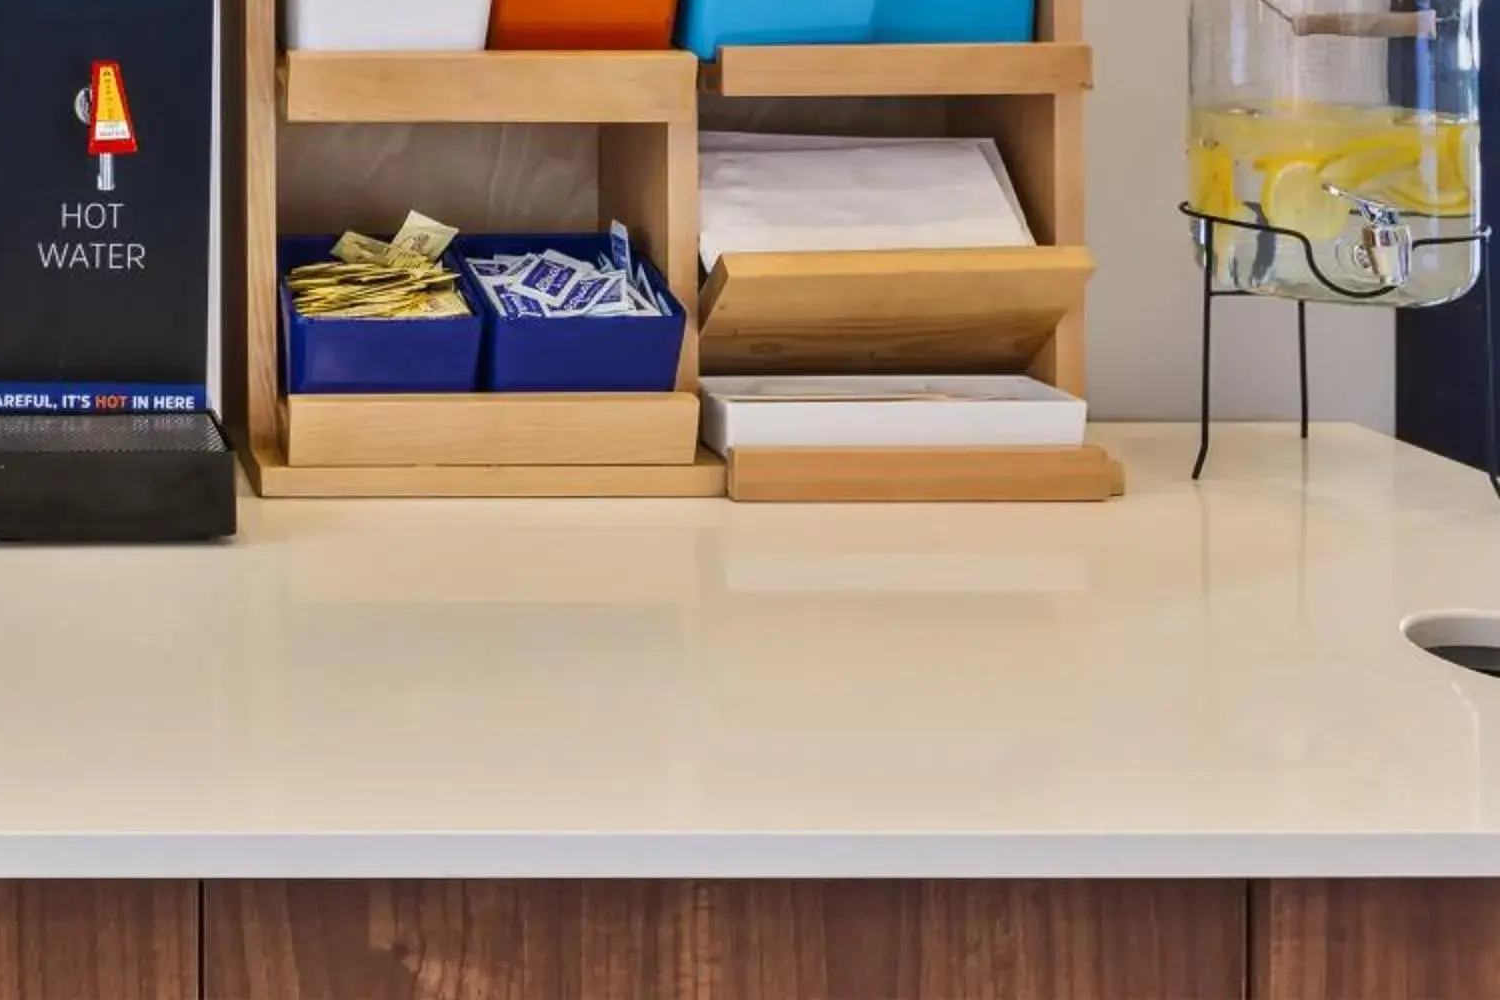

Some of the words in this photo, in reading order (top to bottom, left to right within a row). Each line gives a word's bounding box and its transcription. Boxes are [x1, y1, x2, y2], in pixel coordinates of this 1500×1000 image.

[61, 202, 125, 229] HOT
[37, 242, 146, 270] WATER
[62, 394, 90, 409] IT'S
[94, 395, 128, 409] HOT
[132, 395, 149, 409] IN
[153, 396, 195, 410] HERE
